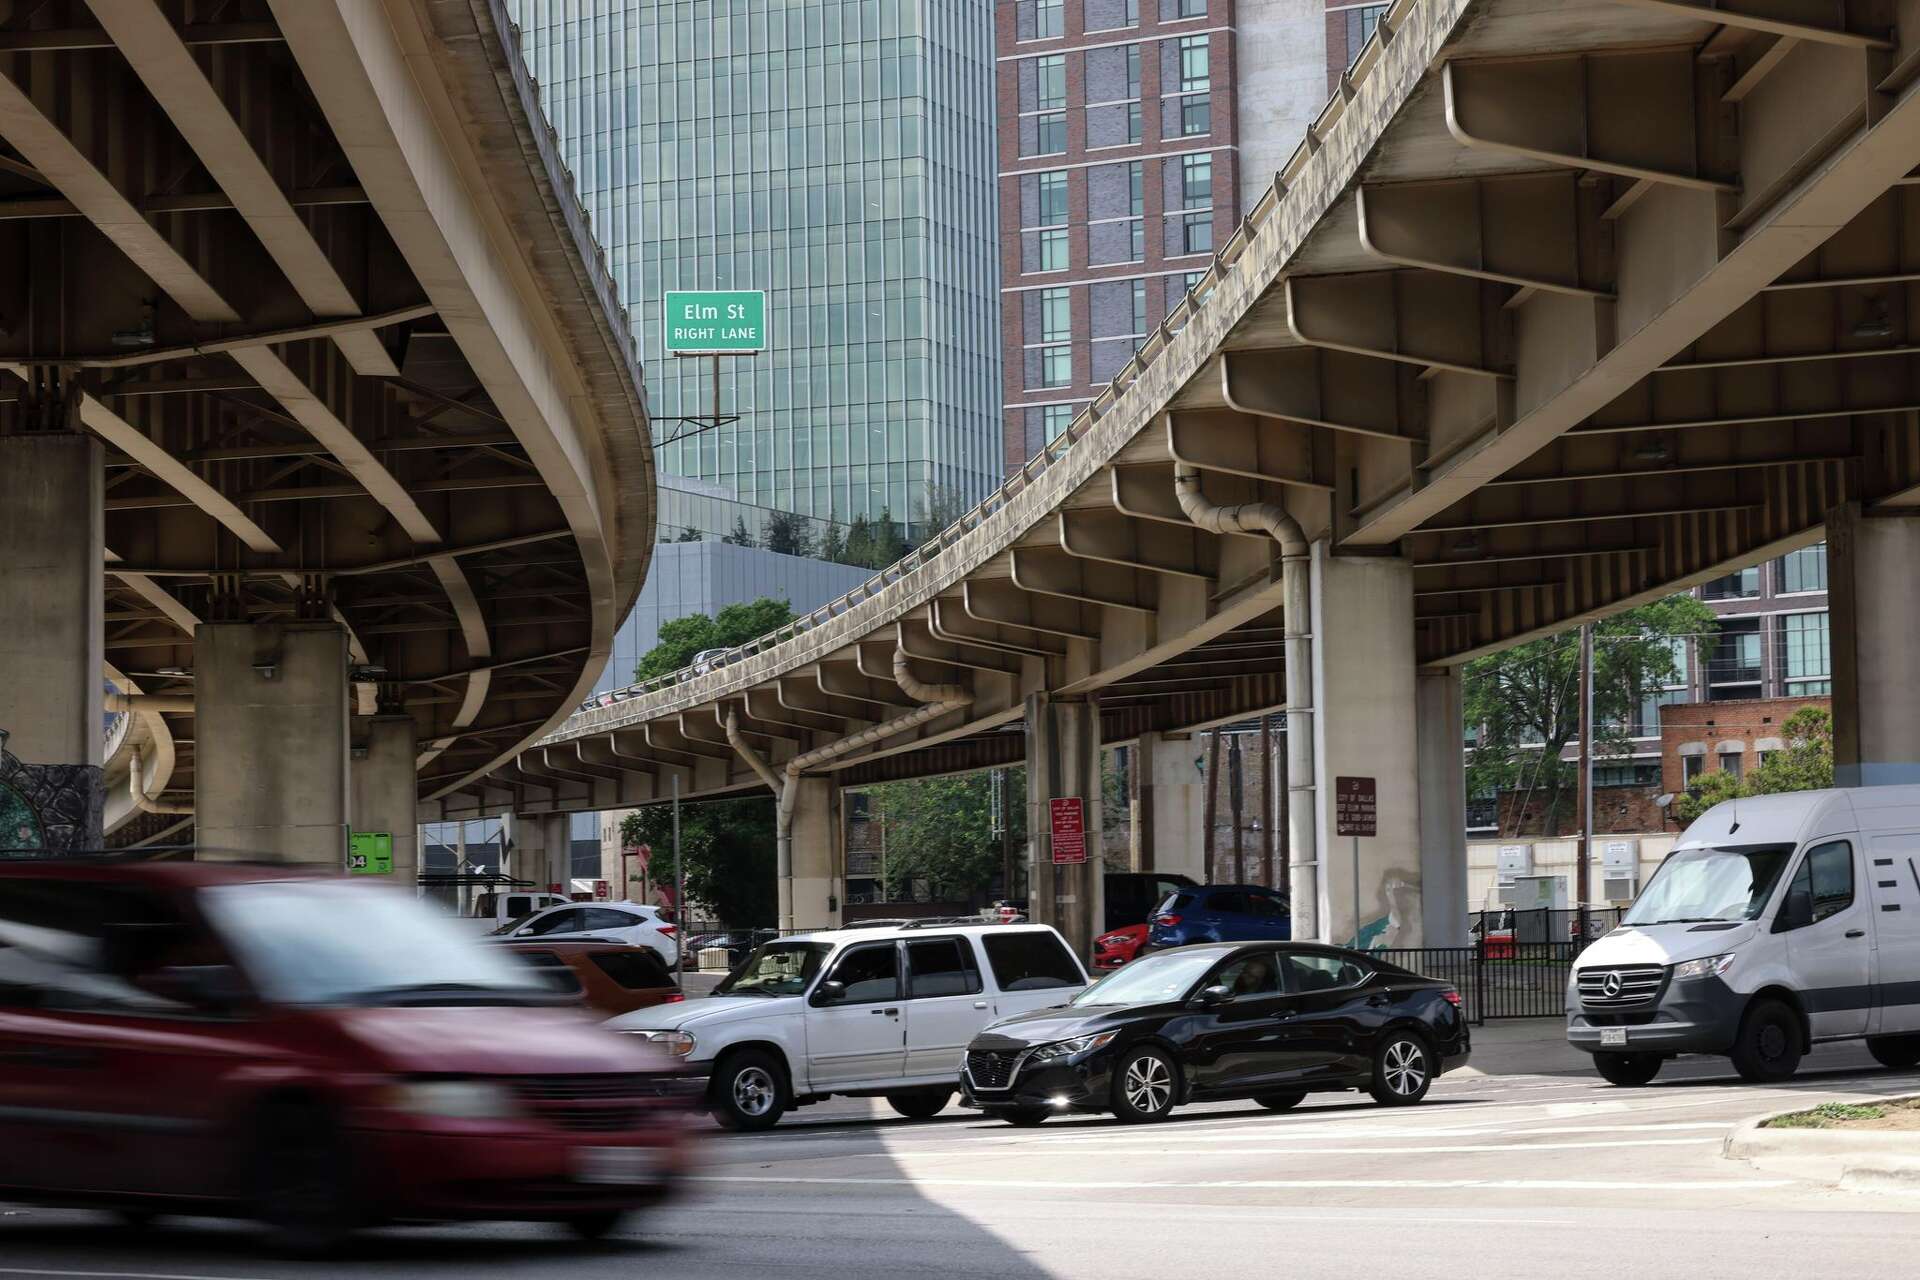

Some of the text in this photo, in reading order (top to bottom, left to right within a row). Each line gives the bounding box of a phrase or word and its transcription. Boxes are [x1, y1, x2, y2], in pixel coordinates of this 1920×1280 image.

[684, 304, 745, 320] Elm St
[674, 327, 756, 340] RIGHT LANE
